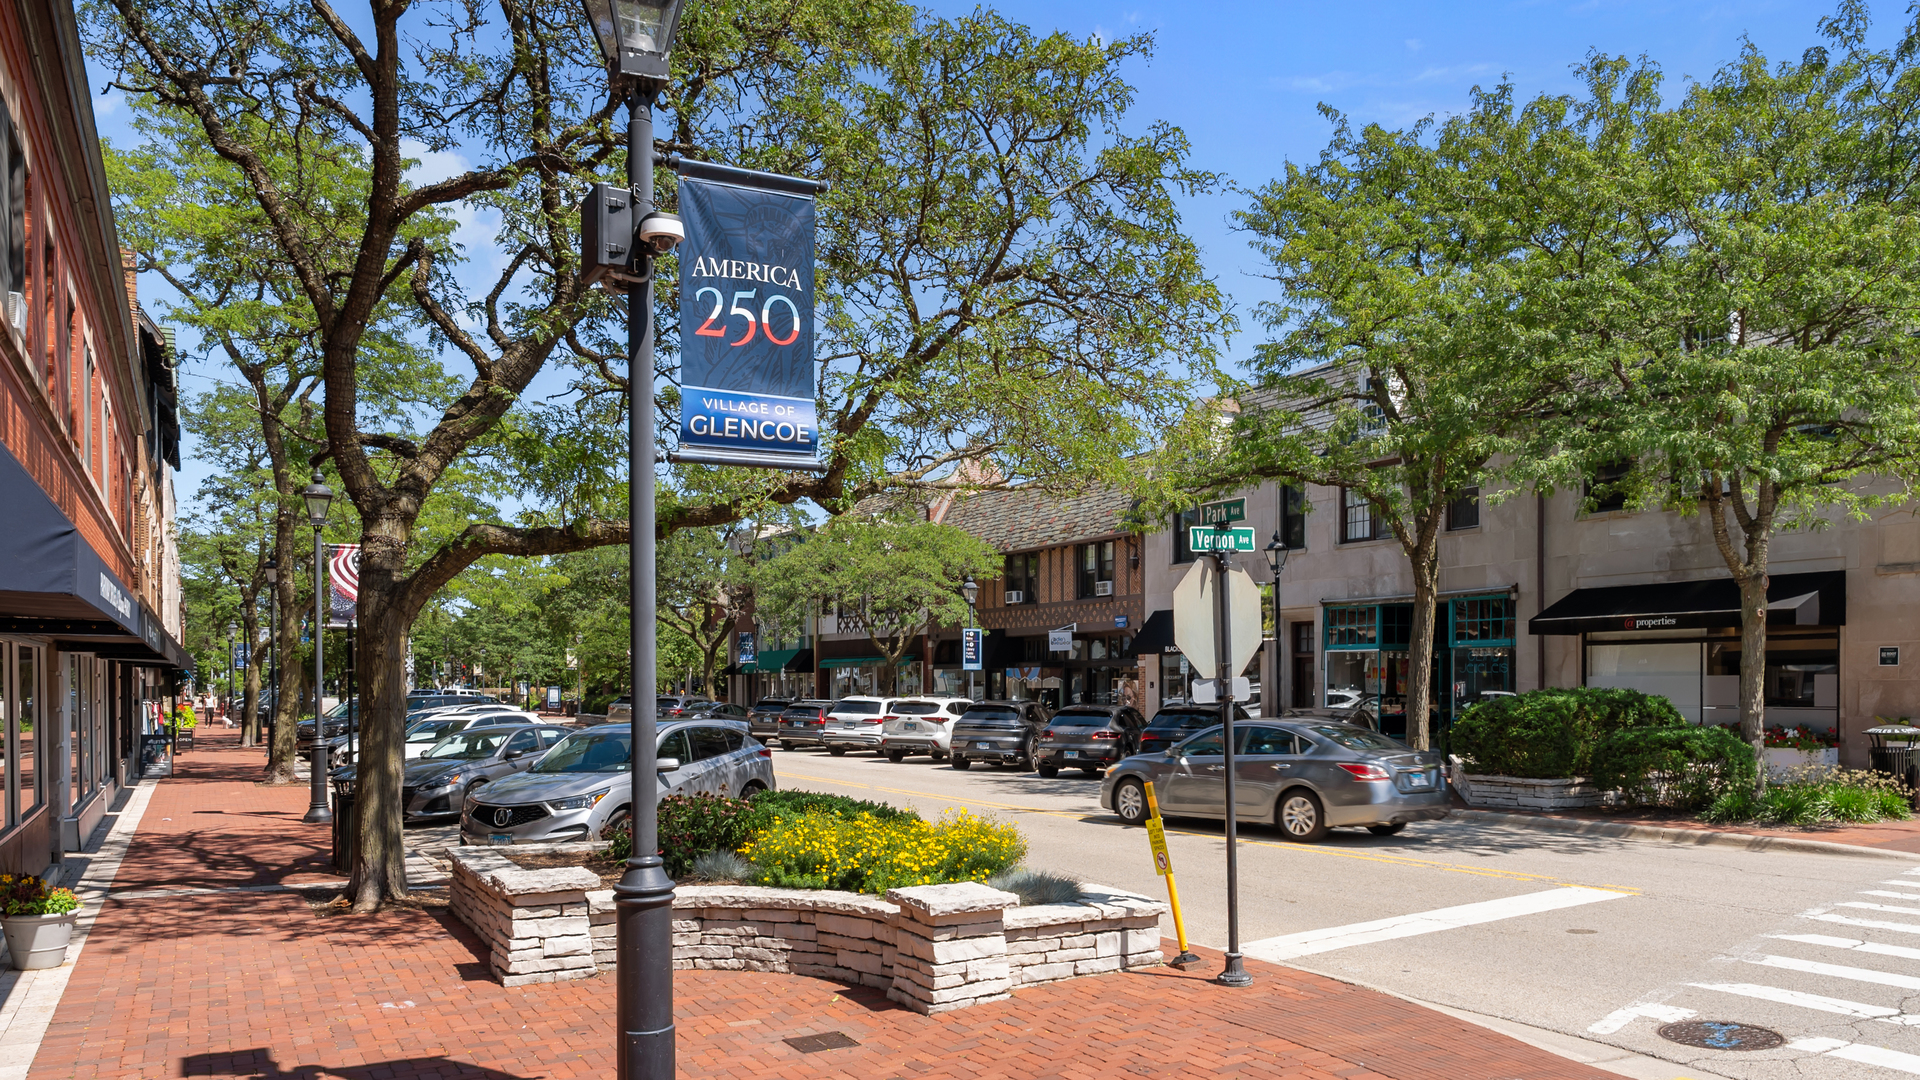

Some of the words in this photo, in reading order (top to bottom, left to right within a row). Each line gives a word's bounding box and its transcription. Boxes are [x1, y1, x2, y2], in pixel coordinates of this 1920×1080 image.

[691, 255, 803, 292] AMERICA
[694, 286, 801, 347] 250
[702, 397, 770, 415] VILLAGE
[774, 404, 795, 416] OF
[689, 414, 810, 444] GLENCOE
[1206, 504, 1227, 524] Park
[1230, 506, 1240, 516] Ave
[1196, 530, 1235, 549] Vernon
[1238, 535, 1249, 544] Ave
[1624, 616, 1677, 630] @properties
